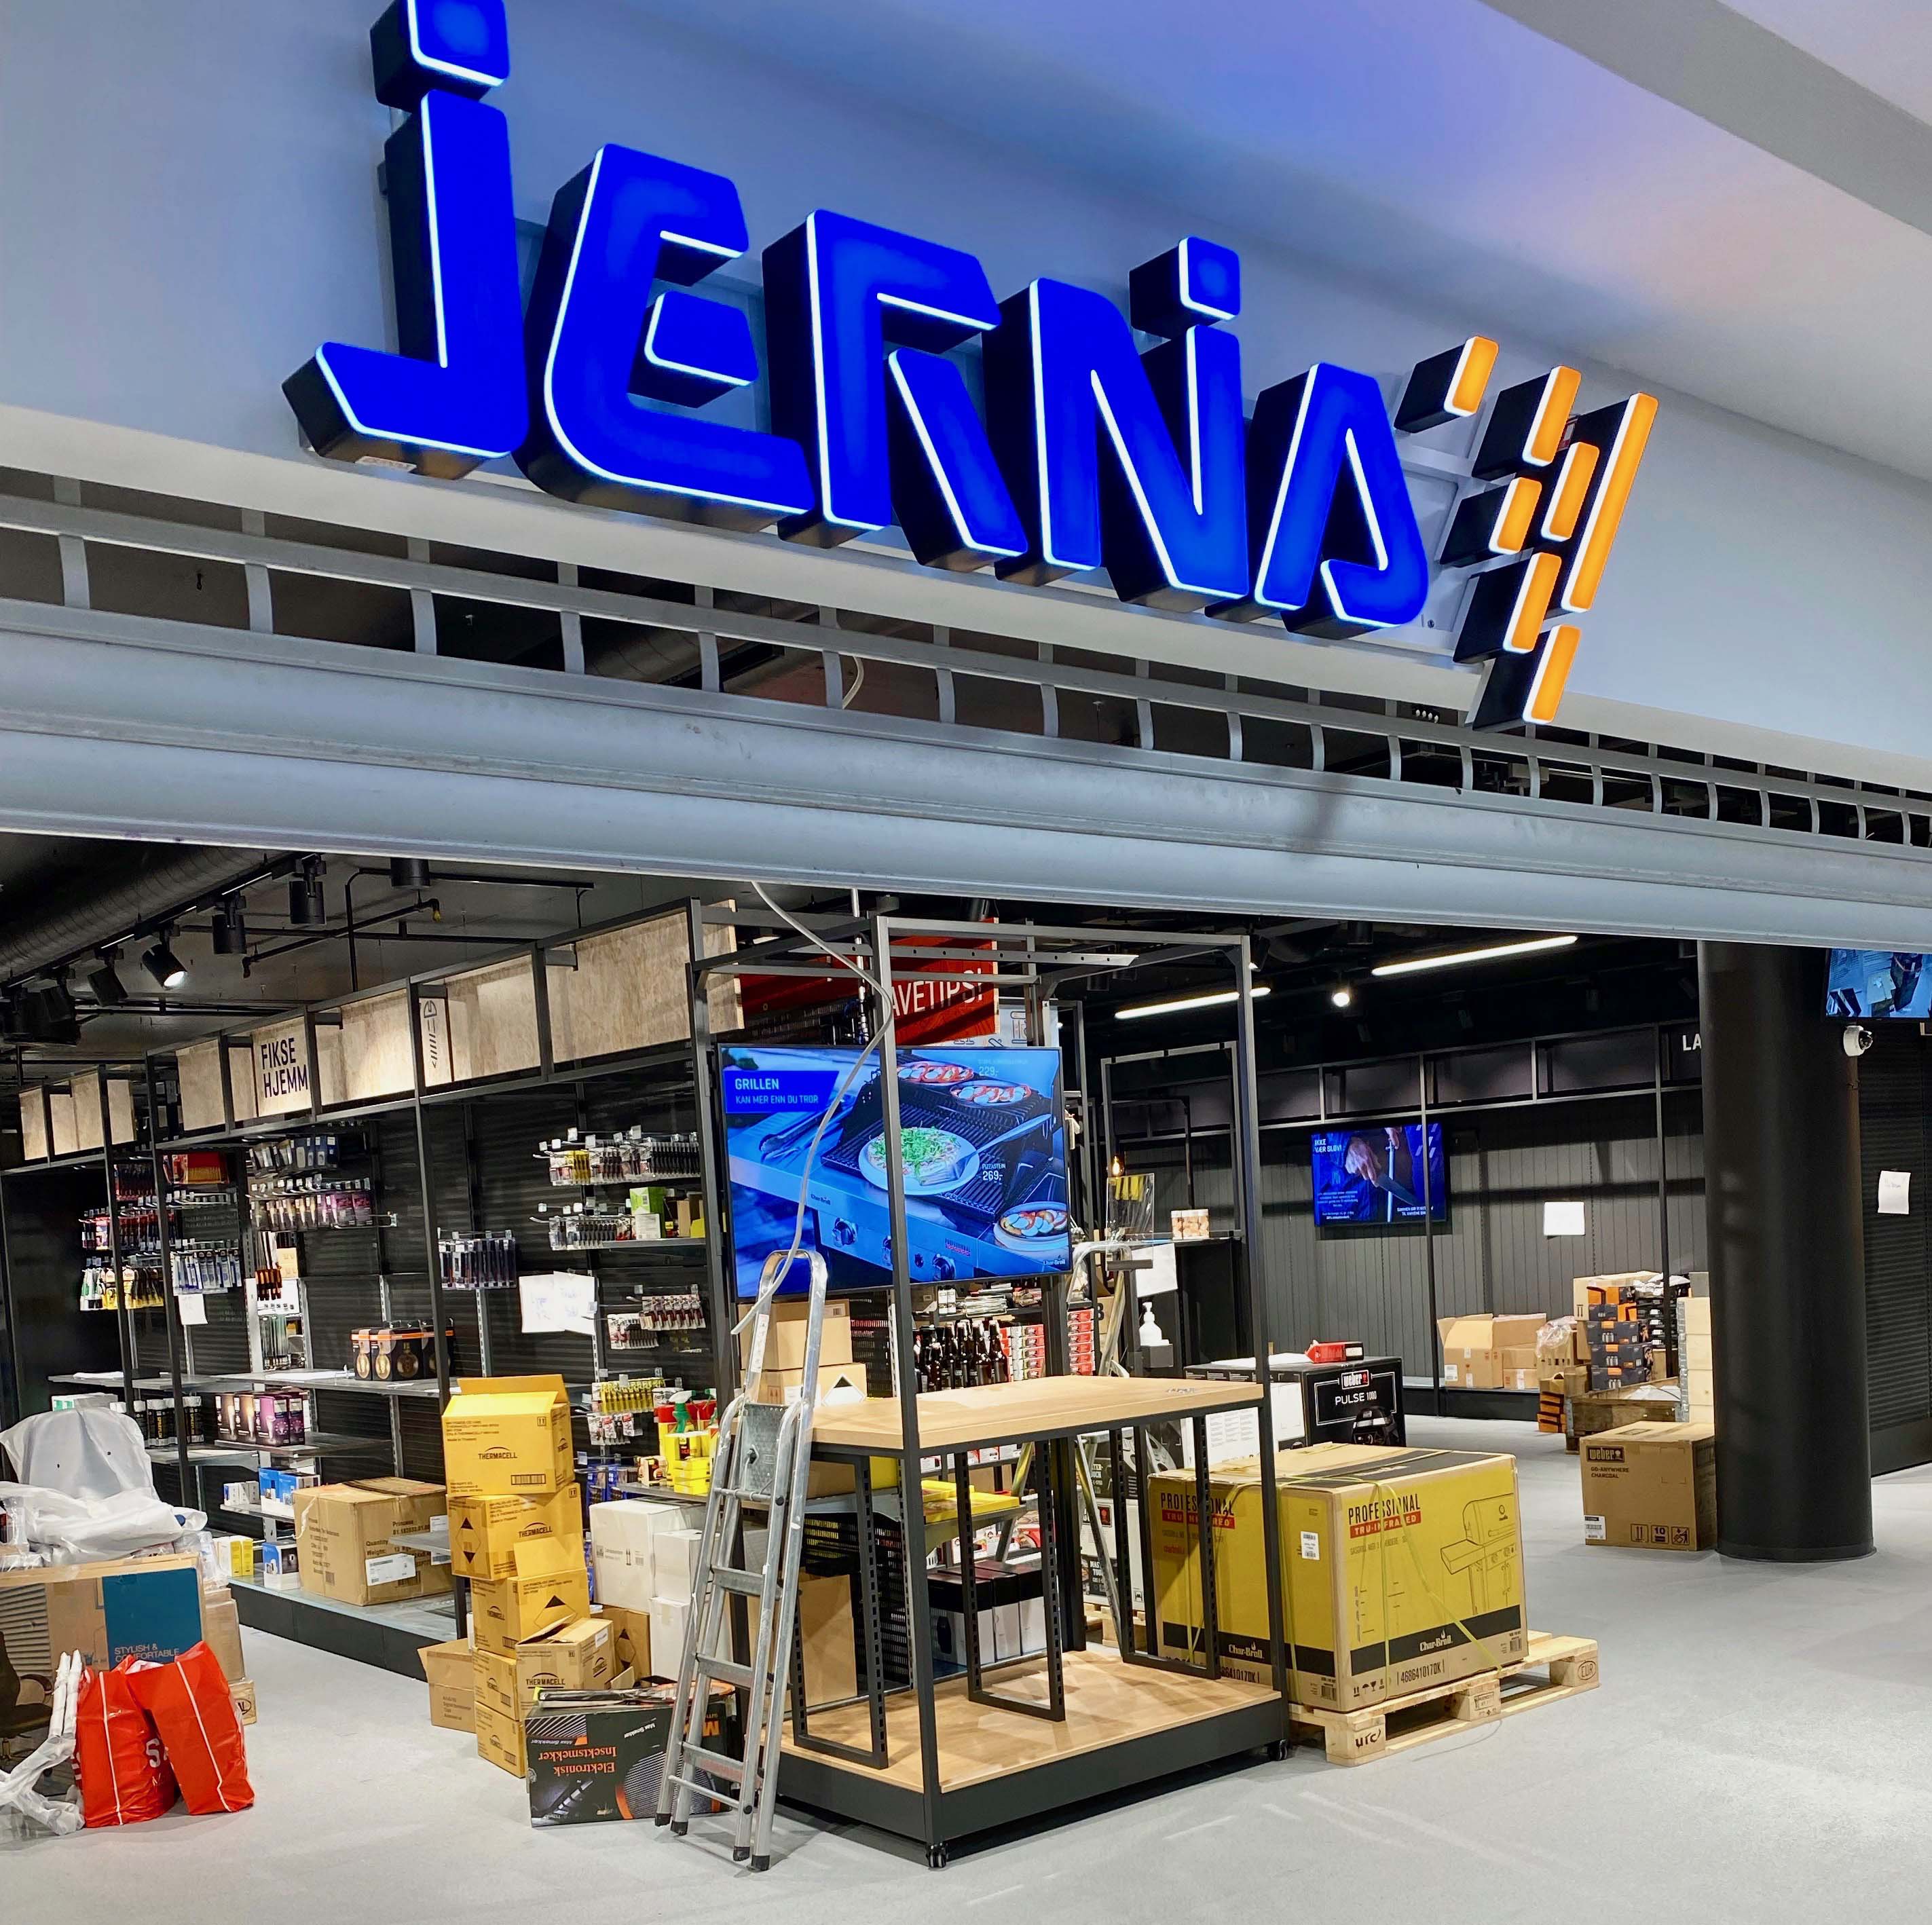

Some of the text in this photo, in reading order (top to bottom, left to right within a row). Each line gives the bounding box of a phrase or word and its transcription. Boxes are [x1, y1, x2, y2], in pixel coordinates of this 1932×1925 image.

[261, 1037, 296, 1070] FIKSE
[263, 1064, 308, 1098] HJEMM
[735, 1078, 779, 1090] GRILLEN
[735, 1095, 819, 1104] KAN MER ENN DU TROR
[1343, 1372, 1362, 1387] weber
[1335, 1392, 1365, 1406] PULSE
[478, 1452, 518, 1460] THERMACELL
[1589, 1446, 1615, 1460] weber
[519, 1526, 553, 1538] THERMACELL
[1419, 1632, 1452, 1651] Char-Broil
[114, 1644, 150, 1656] STYLISH
[115, 1648, 180, 1662] COFORTABLE
[1228, 1643, 1264, 1659] Char-Broil
[1581, 1664, 1593, 1678] EUR
[538, 1746, 617, 1761] Insektsmekker
[553, 1762, 616, 1777] Elektronisk
